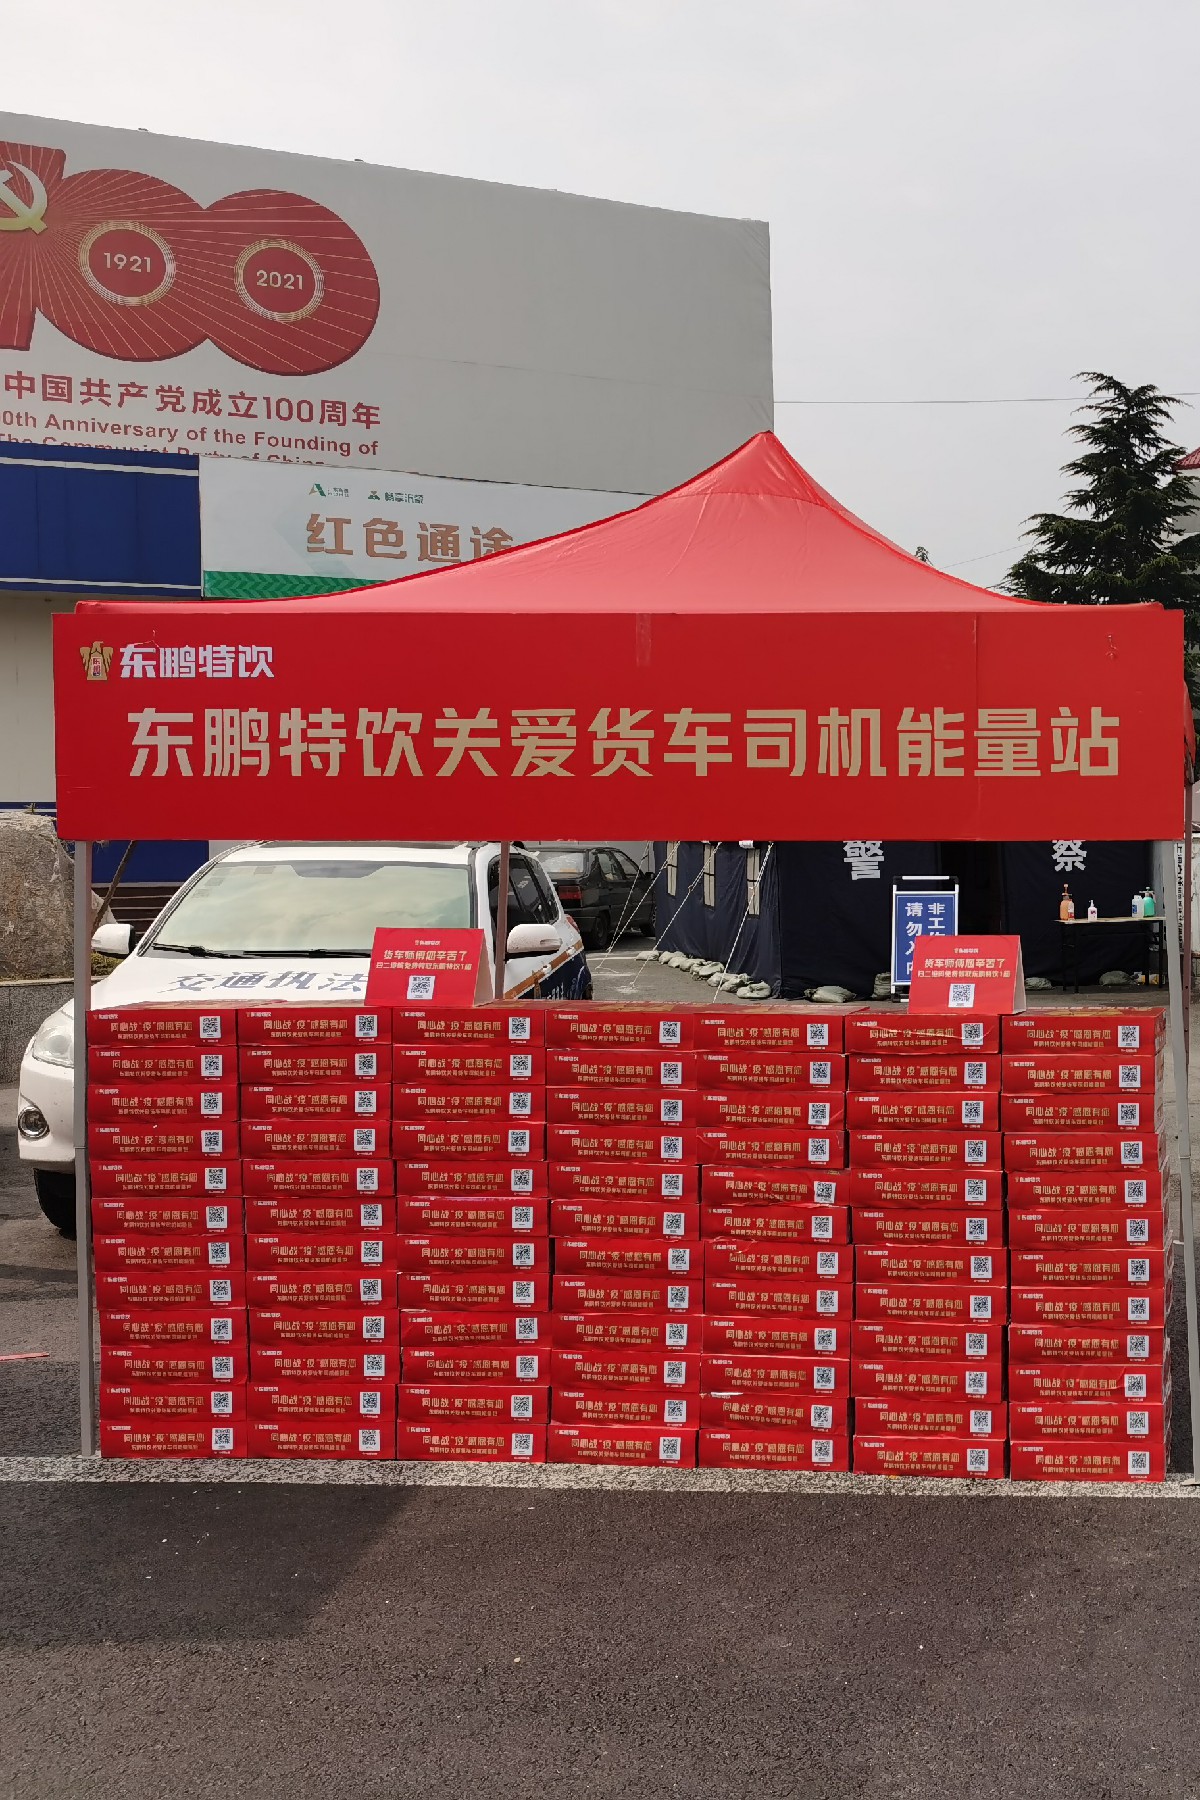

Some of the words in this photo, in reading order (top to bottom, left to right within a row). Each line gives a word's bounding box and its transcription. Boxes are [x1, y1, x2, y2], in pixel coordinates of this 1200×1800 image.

[104, 252, 151, 273] 1921
[256, 269, 303, 290] 2021
[4, 370, 381, 430] 中国共产党成立100周年
[45, 413, 179, 443] Anniversary
[186, 426, 208, 442] of
[213, 428, 246, 444] the
[254, 431, 351, 457] Founding
[358, 440, 379, 456] of
[119, 643, 275, 679] 东鹏特饮
[127, 706, 1120, 779] 东鹏特饮关爱货车司机能量站
[843, 840, 885, 881] 警
[1051, 840, 1088, 873] 察
[927, 902, 946, 936] 非工
[157, 970, 369, 993] 交通执法
